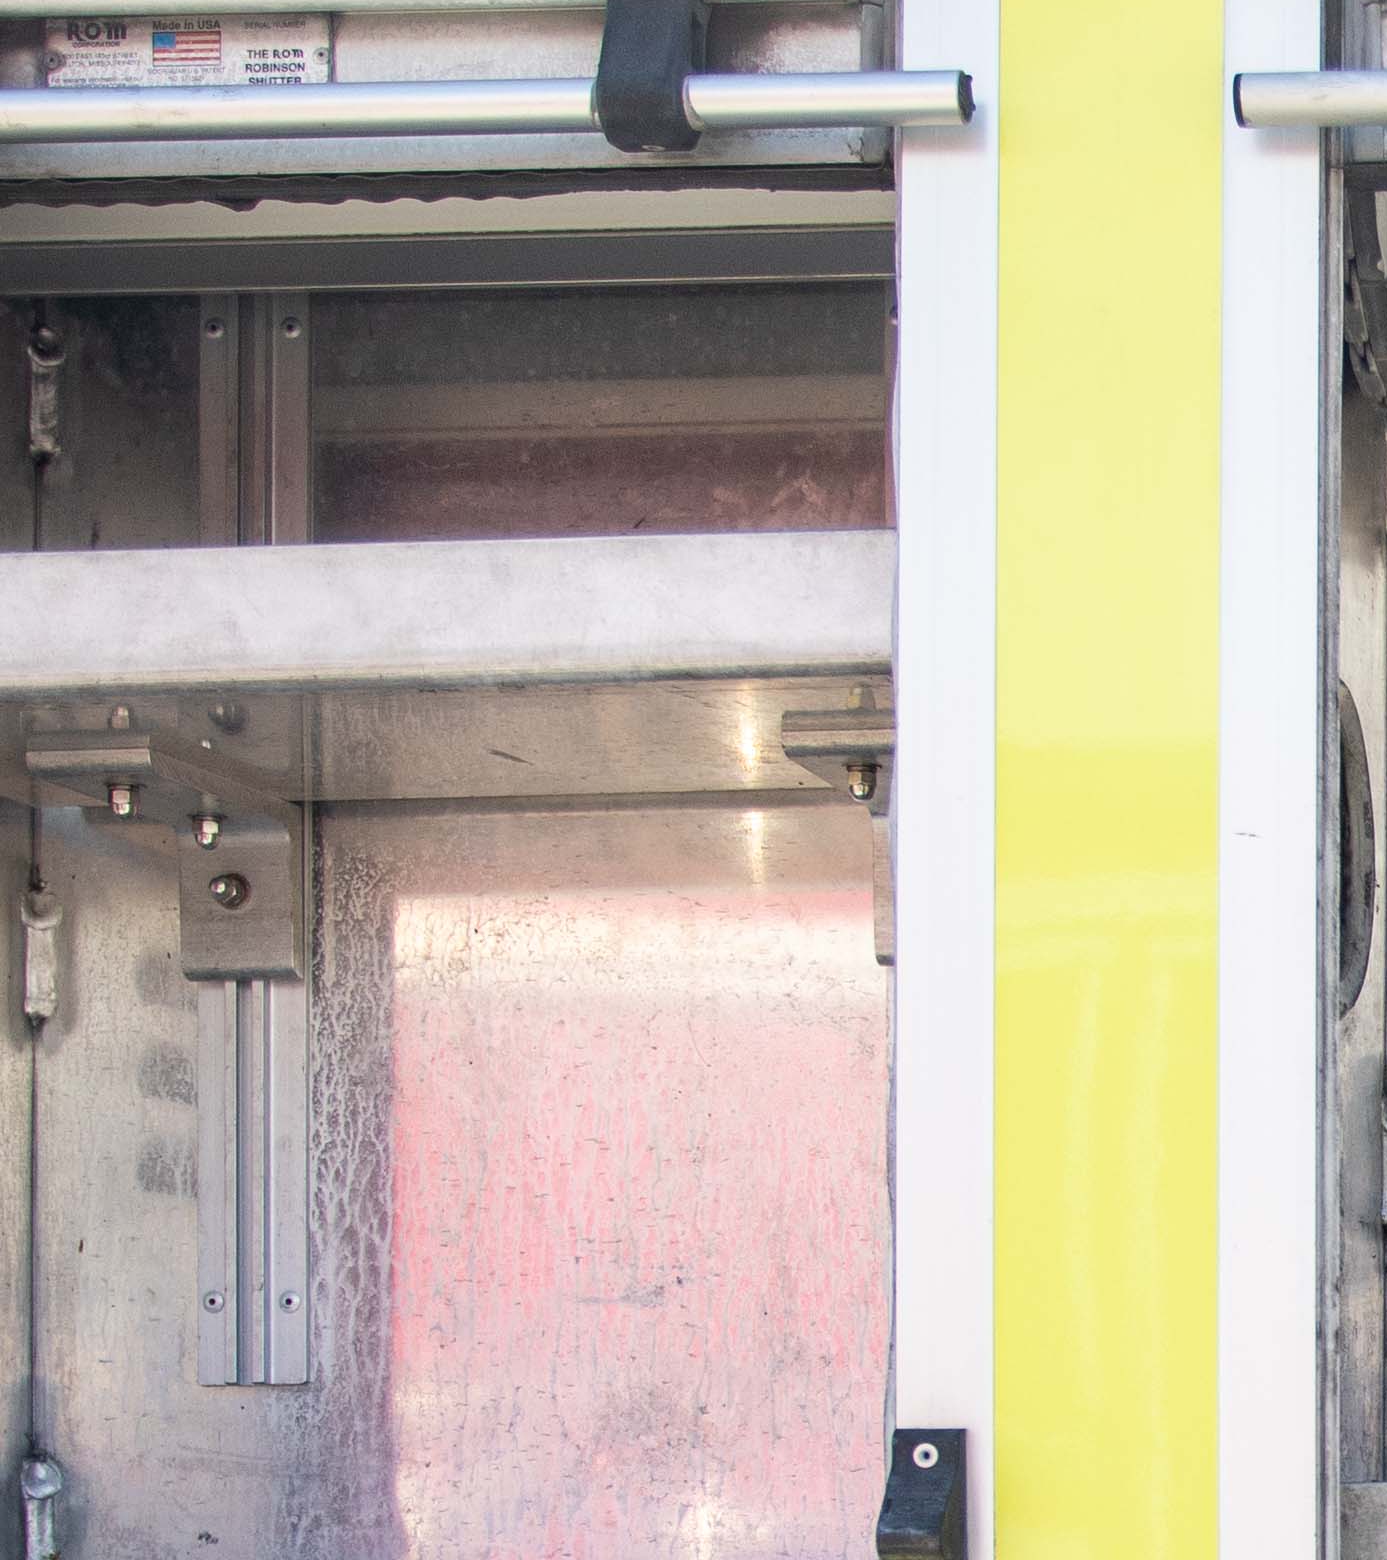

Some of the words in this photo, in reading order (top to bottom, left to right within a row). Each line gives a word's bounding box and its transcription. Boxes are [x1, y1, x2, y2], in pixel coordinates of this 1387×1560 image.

[152, 20, 181, 31] Made
[198, 19, 221, 29] USA
[246, 50, 269, 59] THE
[245, 62, 306, 72] ROBINSON
